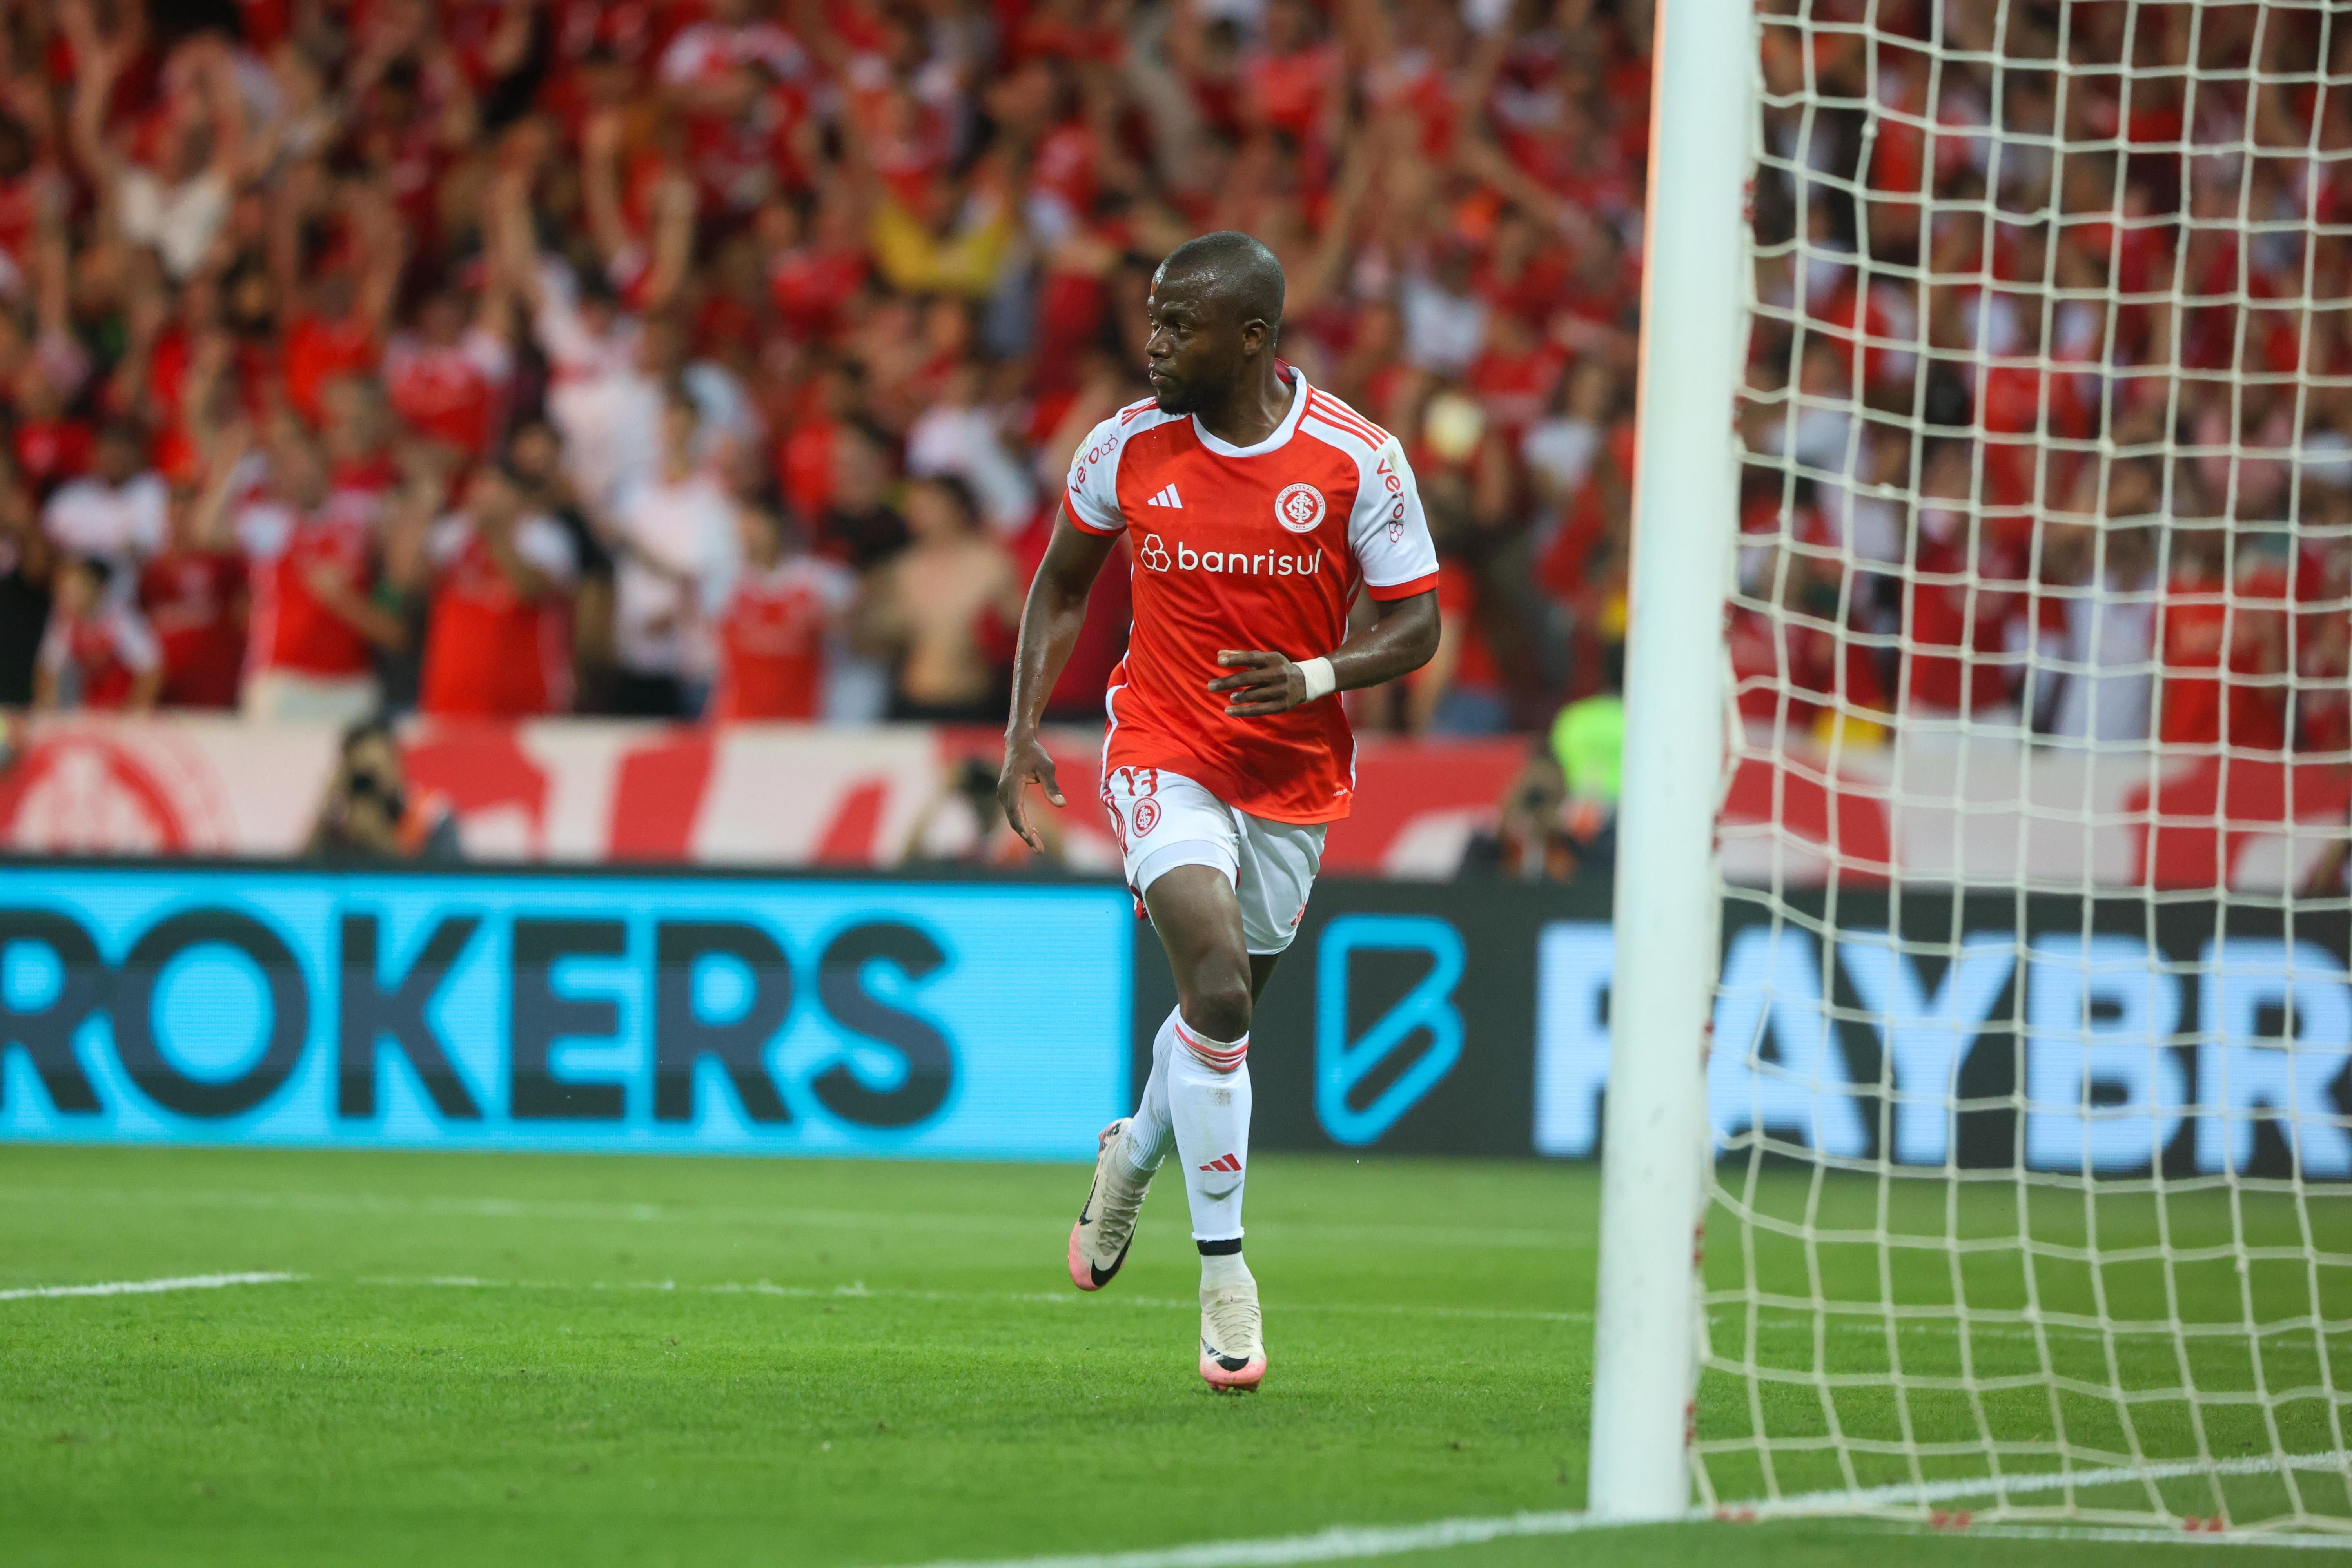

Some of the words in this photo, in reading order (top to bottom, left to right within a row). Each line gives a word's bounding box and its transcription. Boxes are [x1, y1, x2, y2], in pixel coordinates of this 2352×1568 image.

[1178, 541, 1322, 575] banrisul
[1120, 766, 1158, 797] 13
[0, 908, 953, 1127] ROKERS
